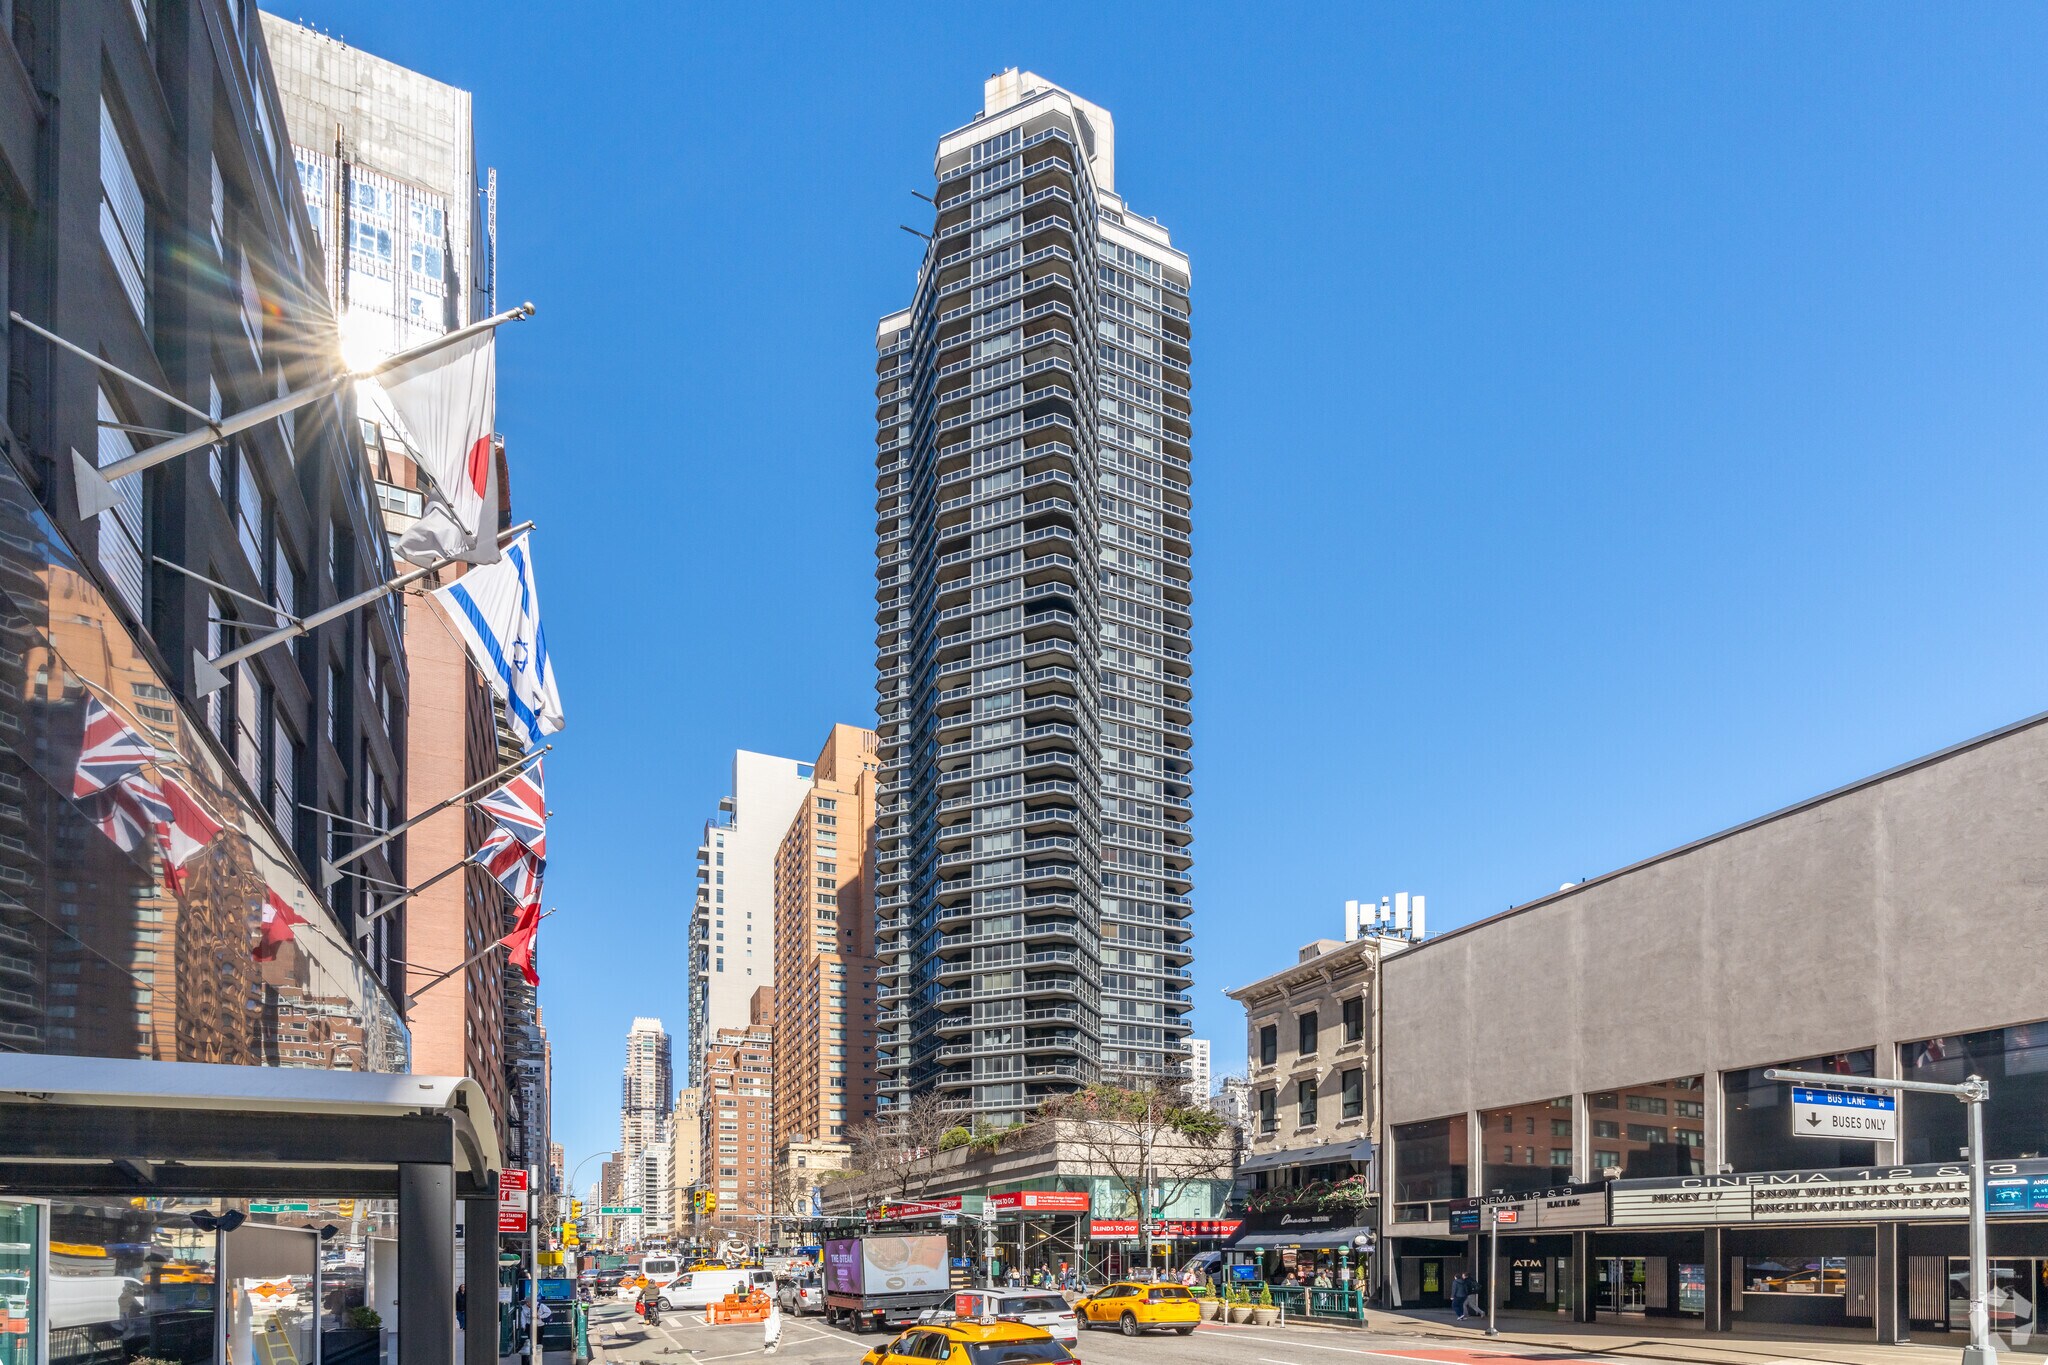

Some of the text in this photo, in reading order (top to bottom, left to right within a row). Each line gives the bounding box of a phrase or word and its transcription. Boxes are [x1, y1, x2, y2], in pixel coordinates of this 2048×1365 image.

[1827, 1094, 1866, 1106] BUS LANE
[1832, 1115, 1886, 1131] BUSES ONLY
[1681, 1173, 1831, 1189] CINEMA
[1936, 1166, 1966, 1177] &
[1989, 1164, 2017, 1175] 3
[1754, 1181, 1968, 1199] SNOW WHITE TIX ON SALE
[1469, 1195, 1516, 1207] CINEMA
[1547, 1189, 1556, 1197] &
[1563, 1188, 1572, 1196] 3
[1547, 1199, 1580, 1209] BLACK BAG
[1652, 1191, 1723, 1204] MICKEY 17
[831, 1254, 853, 1264] THE STEAK
